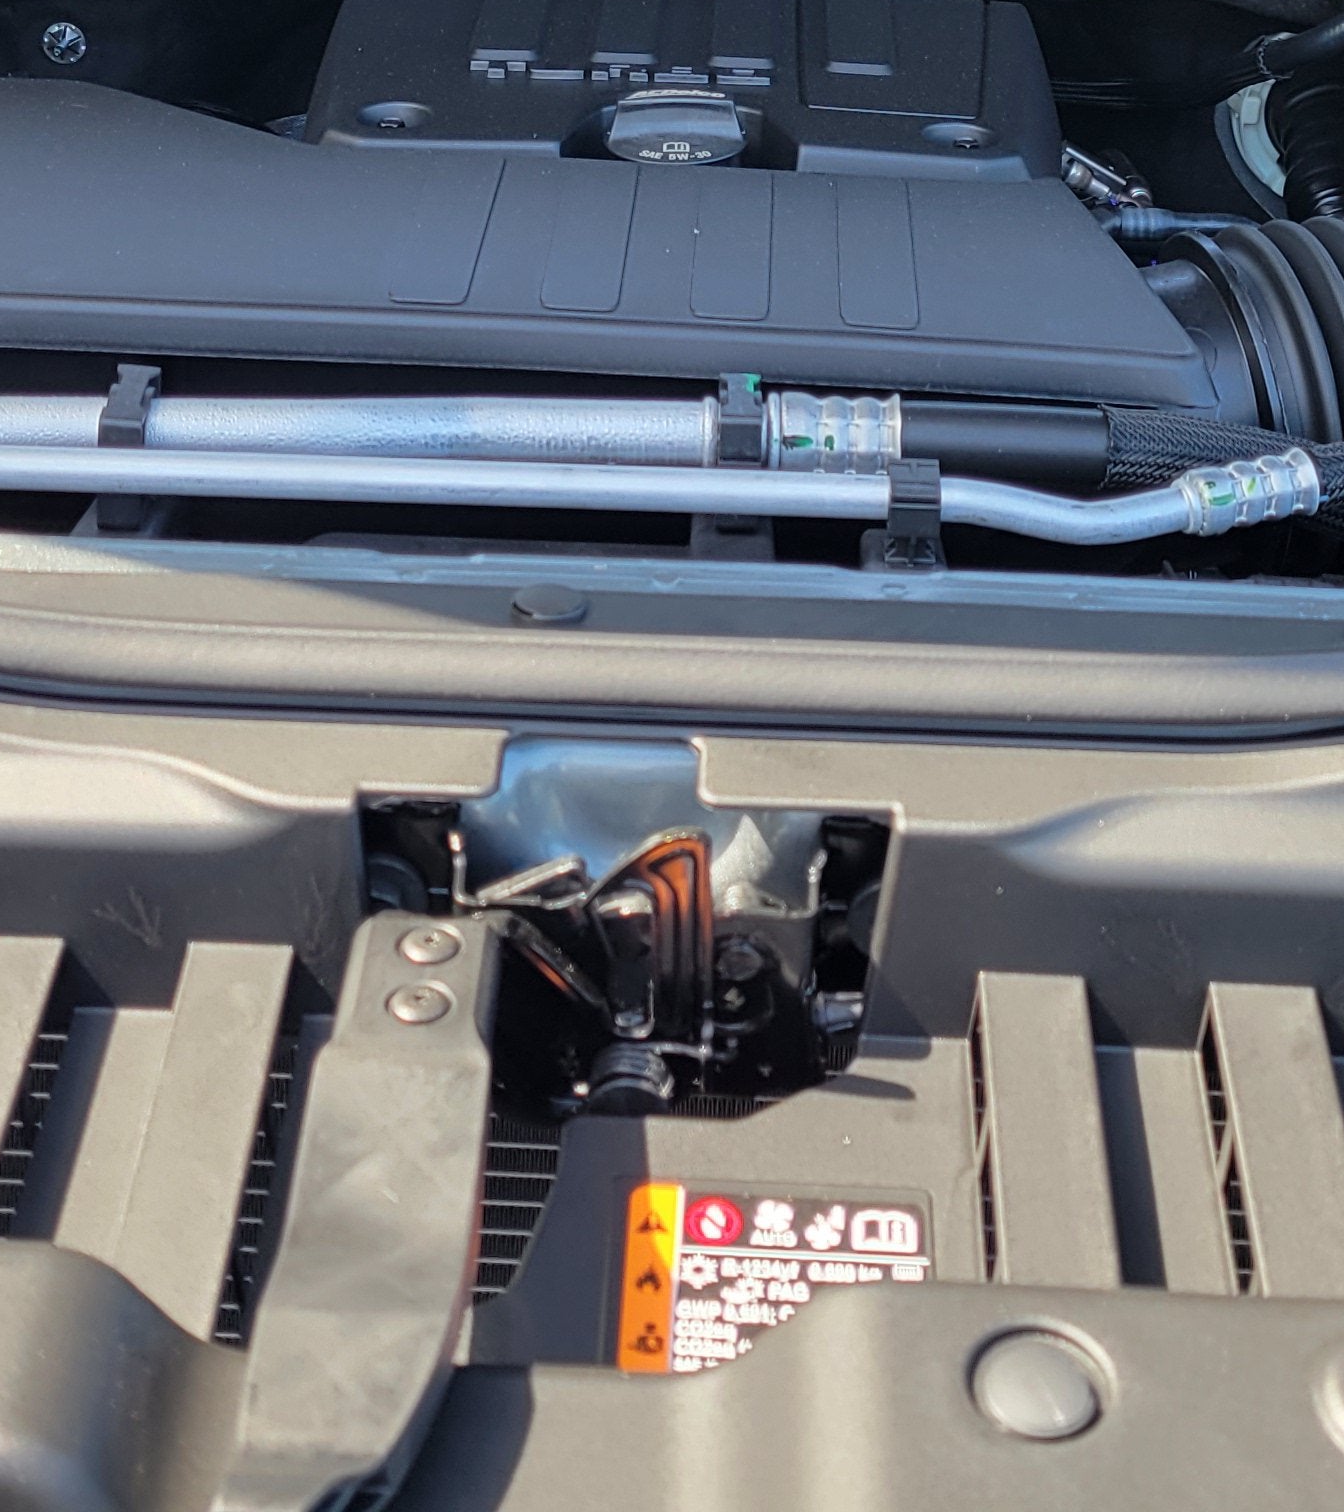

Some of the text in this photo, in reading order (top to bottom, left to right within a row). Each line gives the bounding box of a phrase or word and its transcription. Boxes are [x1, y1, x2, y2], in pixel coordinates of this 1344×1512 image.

[638, 149, 712, 161] SAE 5W-30
[675, 1299, 722, 1320] GWP
